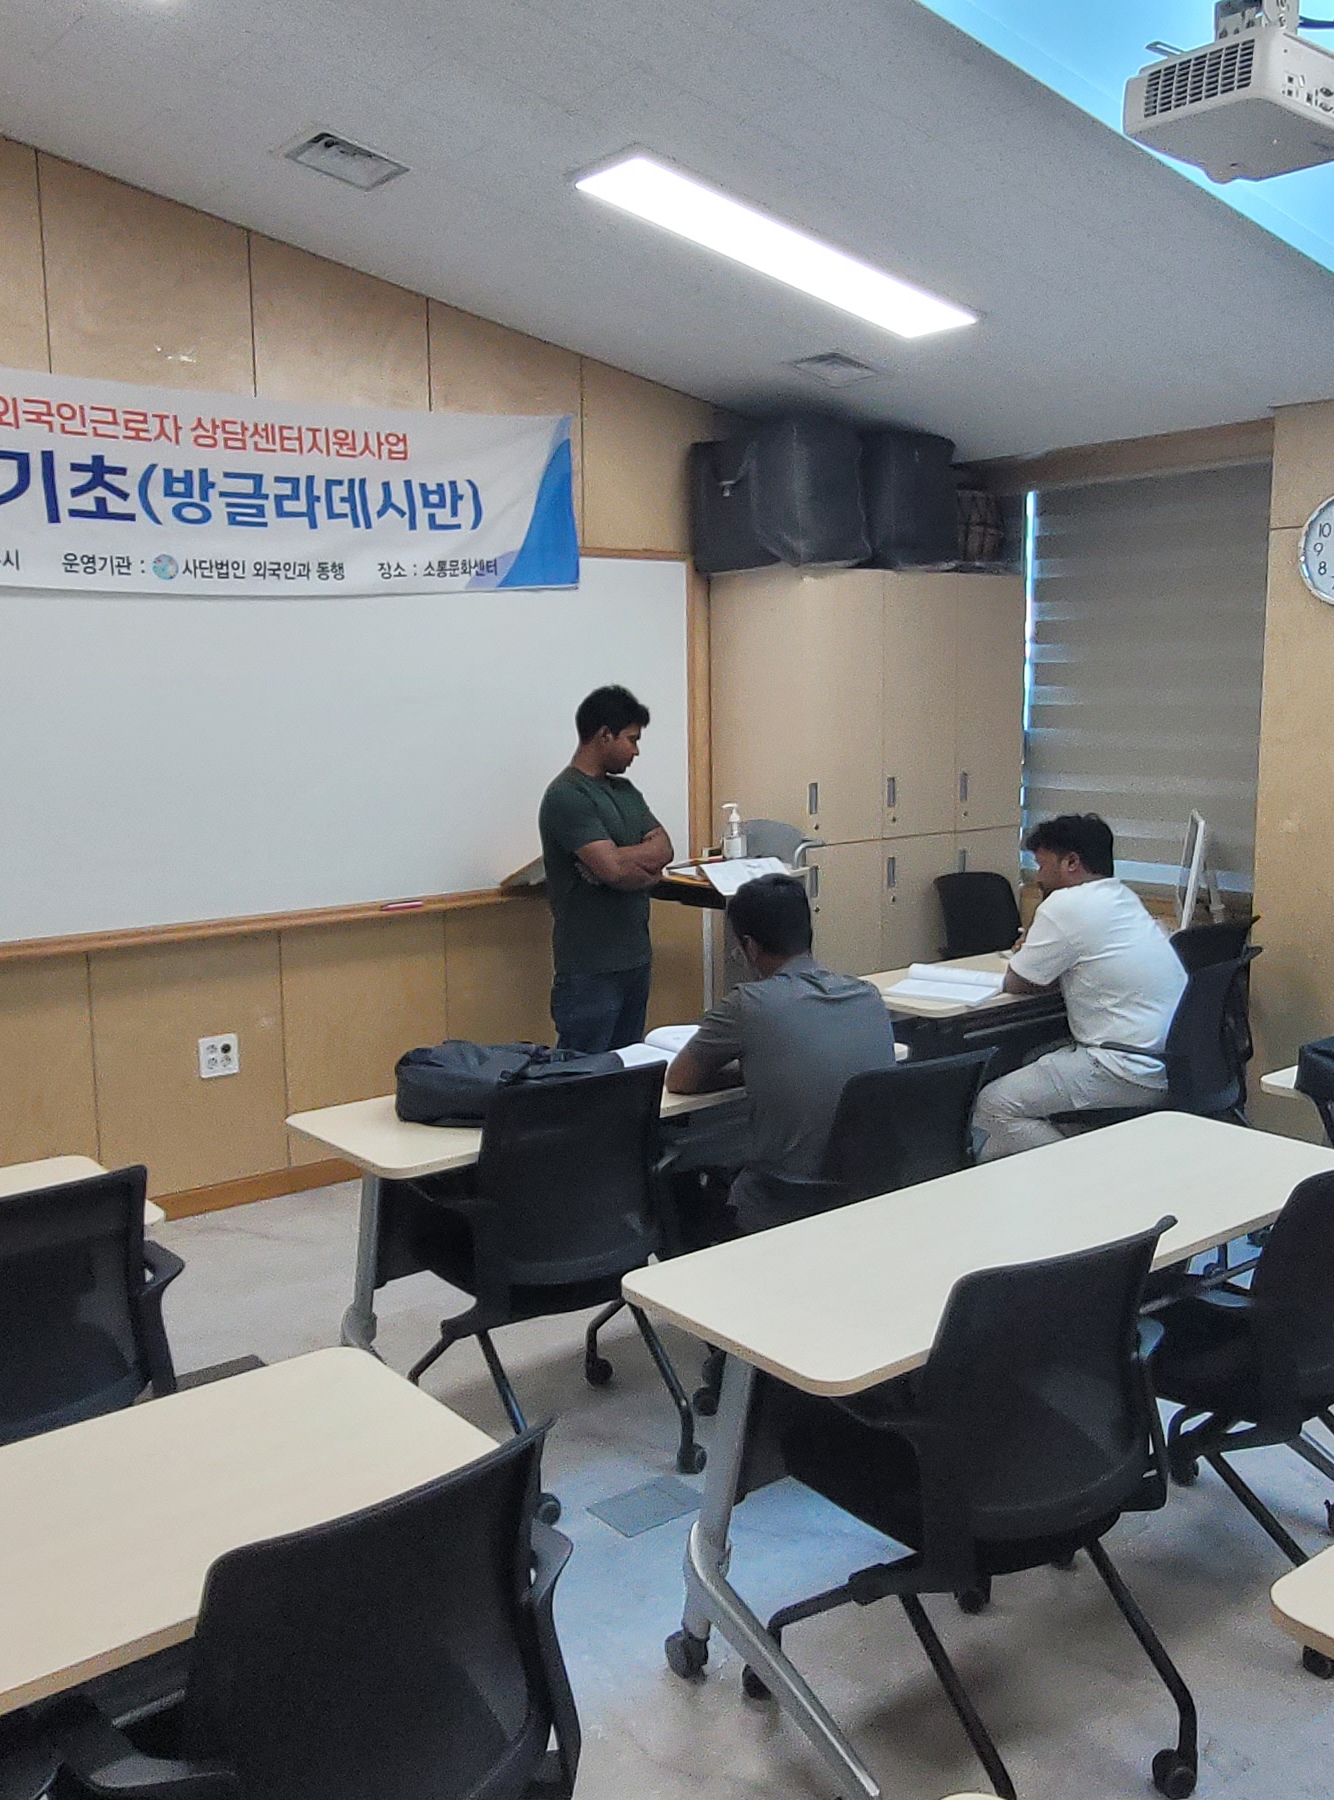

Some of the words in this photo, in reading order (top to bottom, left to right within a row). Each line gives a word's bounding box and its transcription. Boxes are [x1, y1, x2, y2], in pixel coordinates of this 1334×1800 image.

[190, 414, 409, 463] 상담센터지원사업
[1319, 522, 1332, 538] 10
[1313, 542, 1324, 557] 9
[61, 552, 133, 577] 운영기관
[182, 558, 247, 580] 사단법인
[252, 560, 311, 581] 외국인과
[316, 561, 346, 582] 동행
[378, 562, 408, 580] 장소
[1318, 561, 1327, 576] 8
